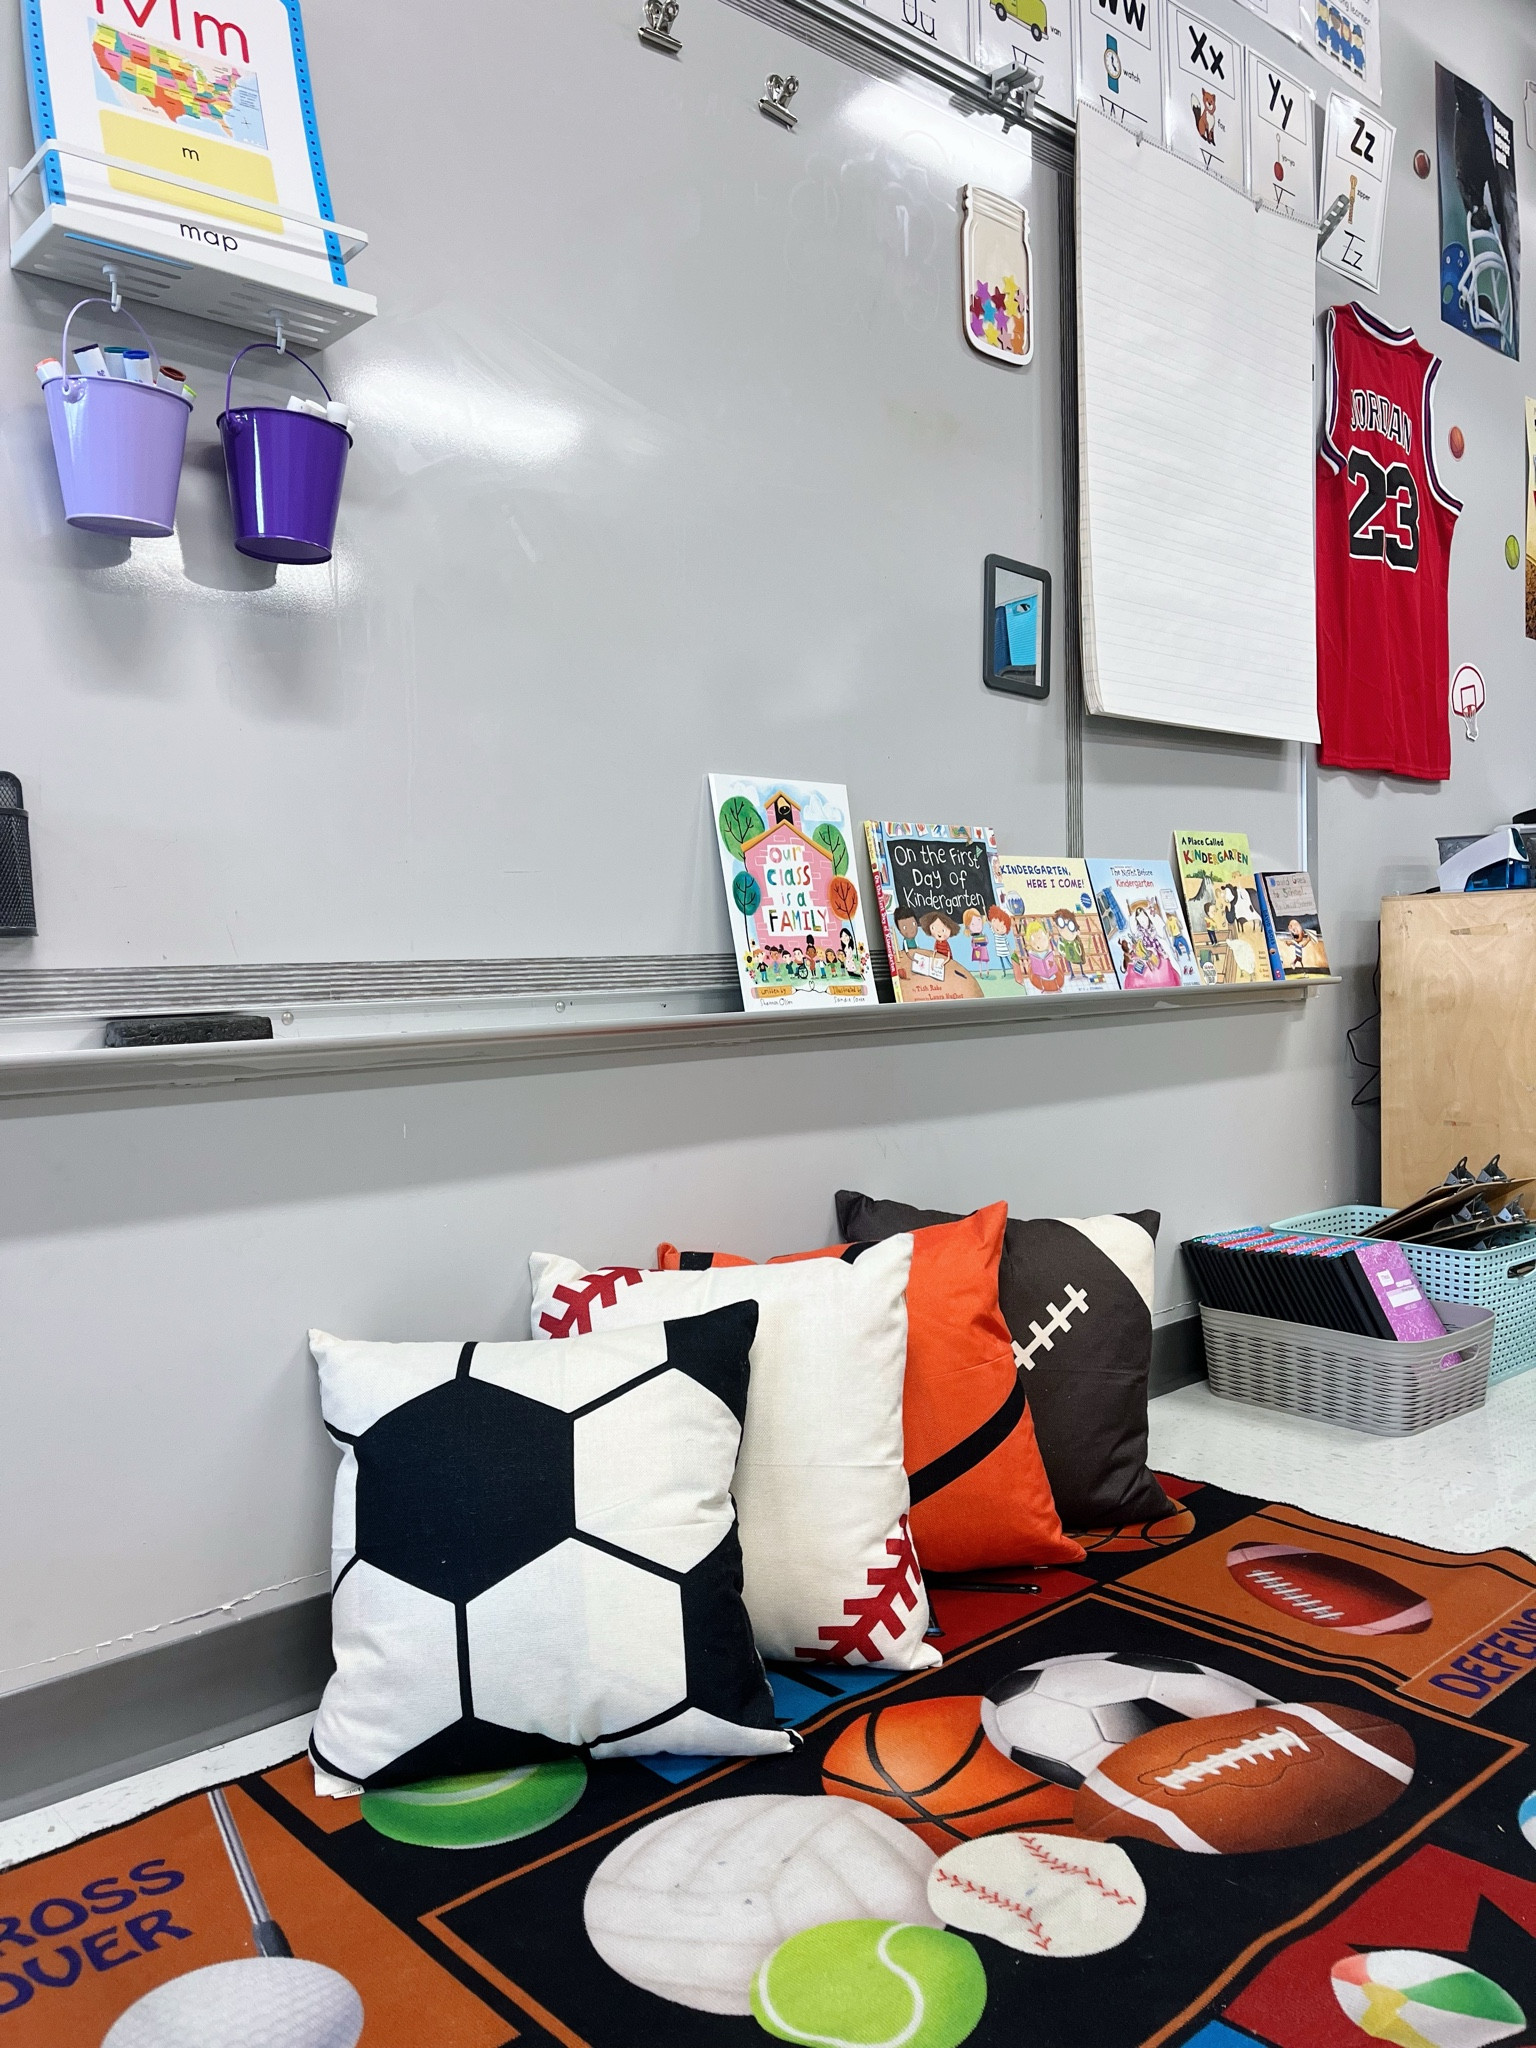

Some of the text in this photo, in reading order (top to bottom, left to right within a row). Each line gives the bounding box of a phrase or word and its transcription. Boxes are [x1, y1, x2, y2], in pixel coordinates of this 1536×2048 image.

[1189, 25, 1225, 80] Xx
[1123, 69, 1141, 84] watch
[1268, 73, 1293, 130] Yy
[1350, 117, 1376, 164] Zz
[182, 147, 200, 162] m
[179, 222, 239, 252] map
[1350, 389, 1412, 456] JORDAN
[1347, 445, 1420, 574] 23
[1181, 836, 1224, 847] A Place Called
[894, 845, 981, 869] On the First
[1183, 848, 1248, 866] KINDERGARTEN
[912, 868, 942, 889] Day
[1000, 864, 1071, 876] KINDERGARTEN,
[1110, 867, 1121, 876] The
[1137, 868, 1154, 877] Before
[1026, 878, 1085, 889] HERE I COME!
[1115, 879, 1155, 889] Kindergarten
[781, 891, 807, 907] is a
[902, 887, 985, 915] Kindergarten
[768, 909, 827, 933] FAMILY
[1428, 1608, 1536, 1699] DEFEN
